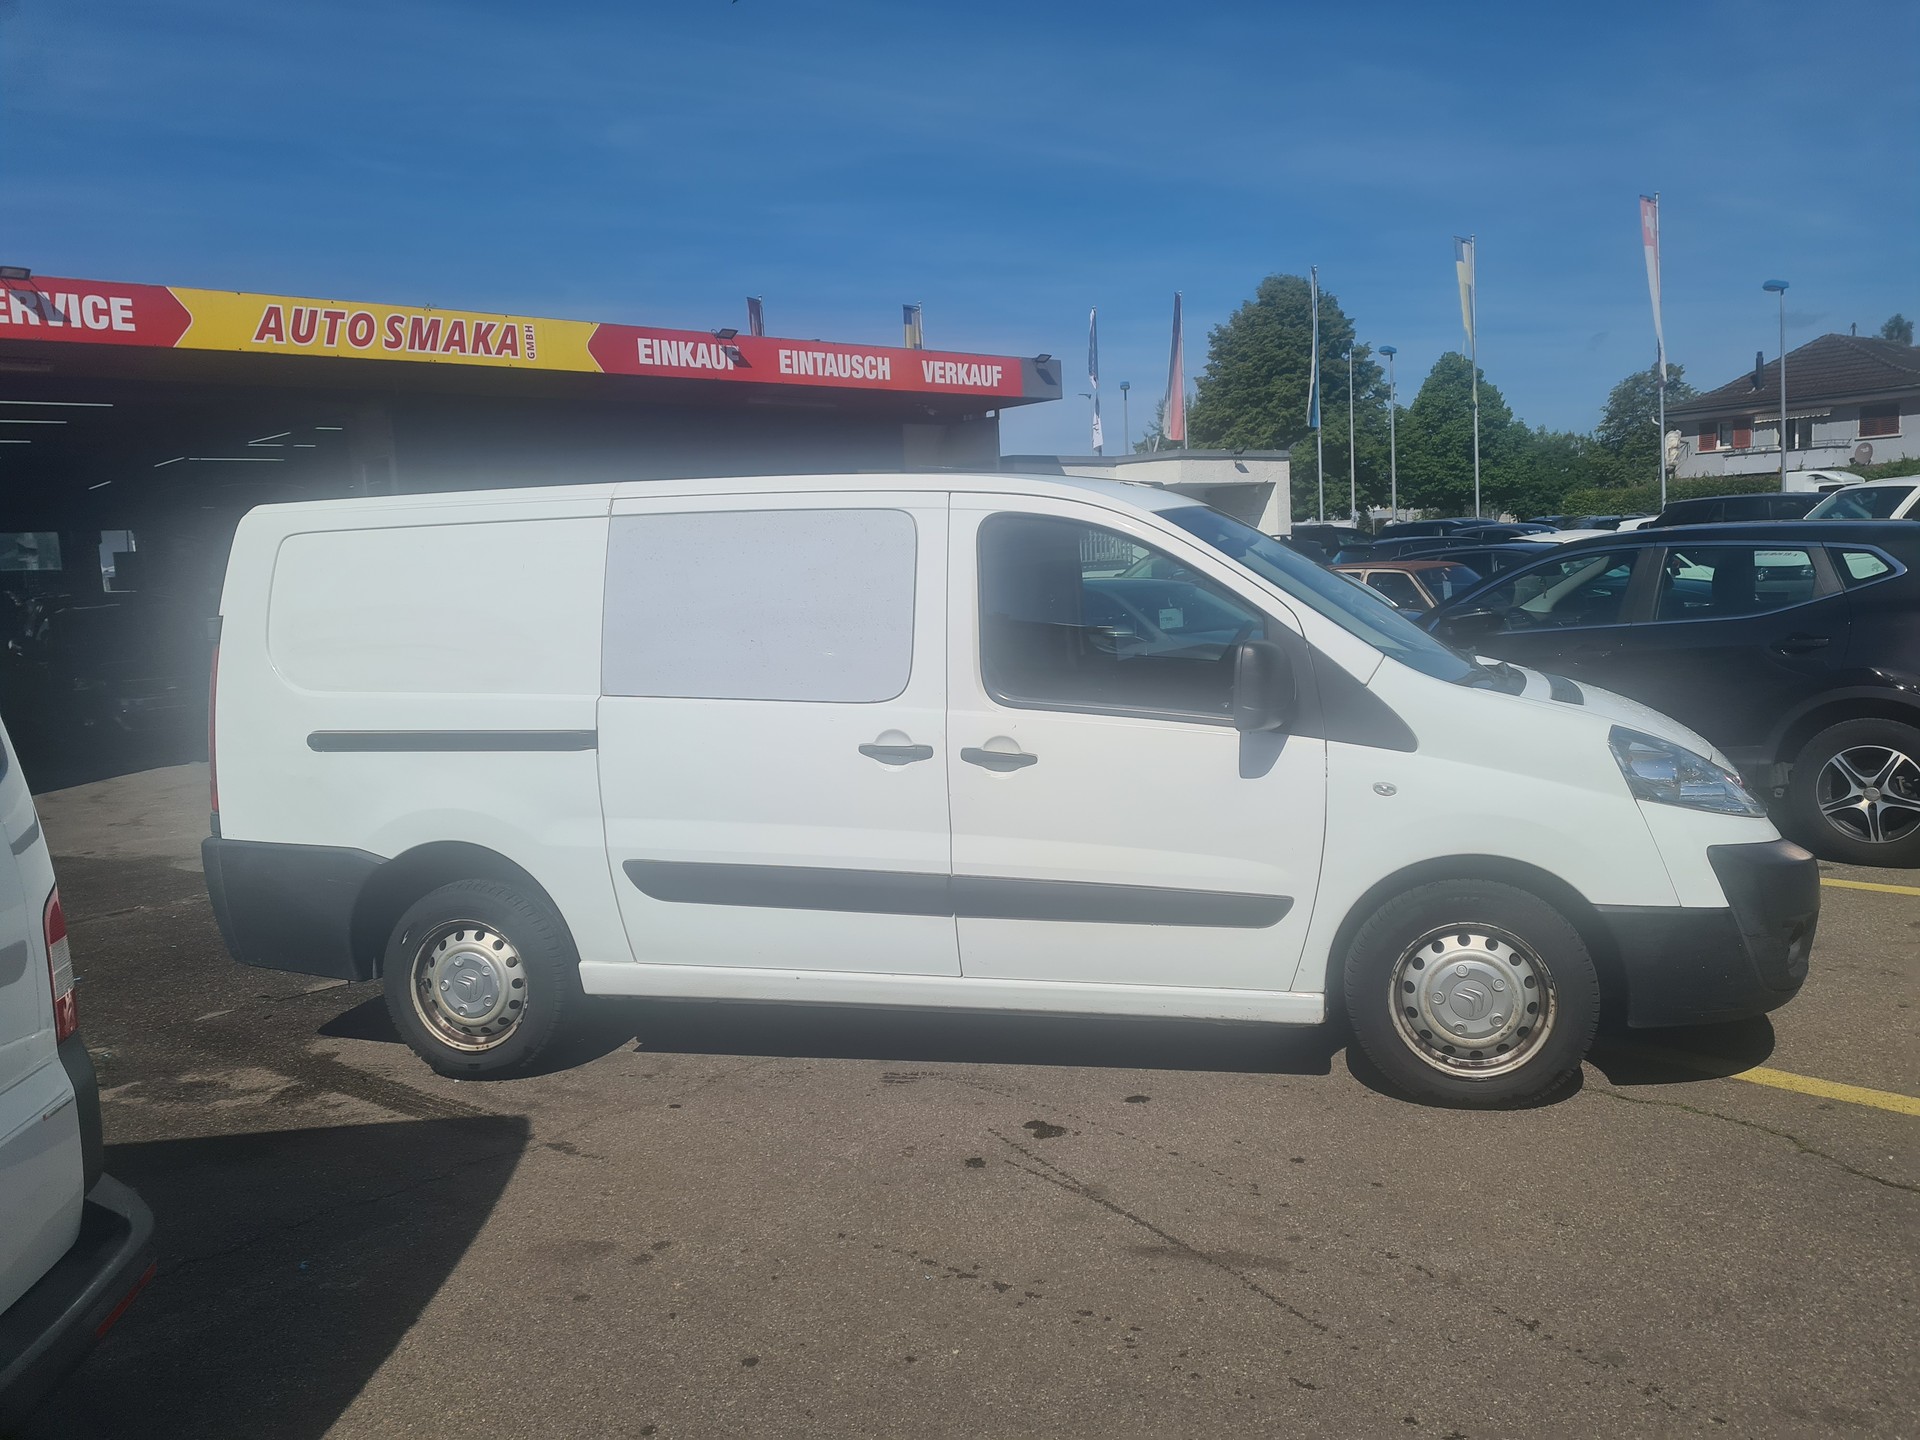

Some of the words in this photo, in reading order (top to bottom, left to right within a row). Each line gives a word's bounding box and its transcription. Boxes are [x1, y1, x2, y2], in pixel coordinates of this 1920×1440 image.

[252, 303, 377, 350] AUTO
[383, 313, 521, 359] SMAKA
[523, 323, 537, 361] GMBH
[637, 337, 740, 371] EINKAUF
[778, 349, 891, 381] EINTAUSCH
[921, 359, 1003, 388] VERKAUF
